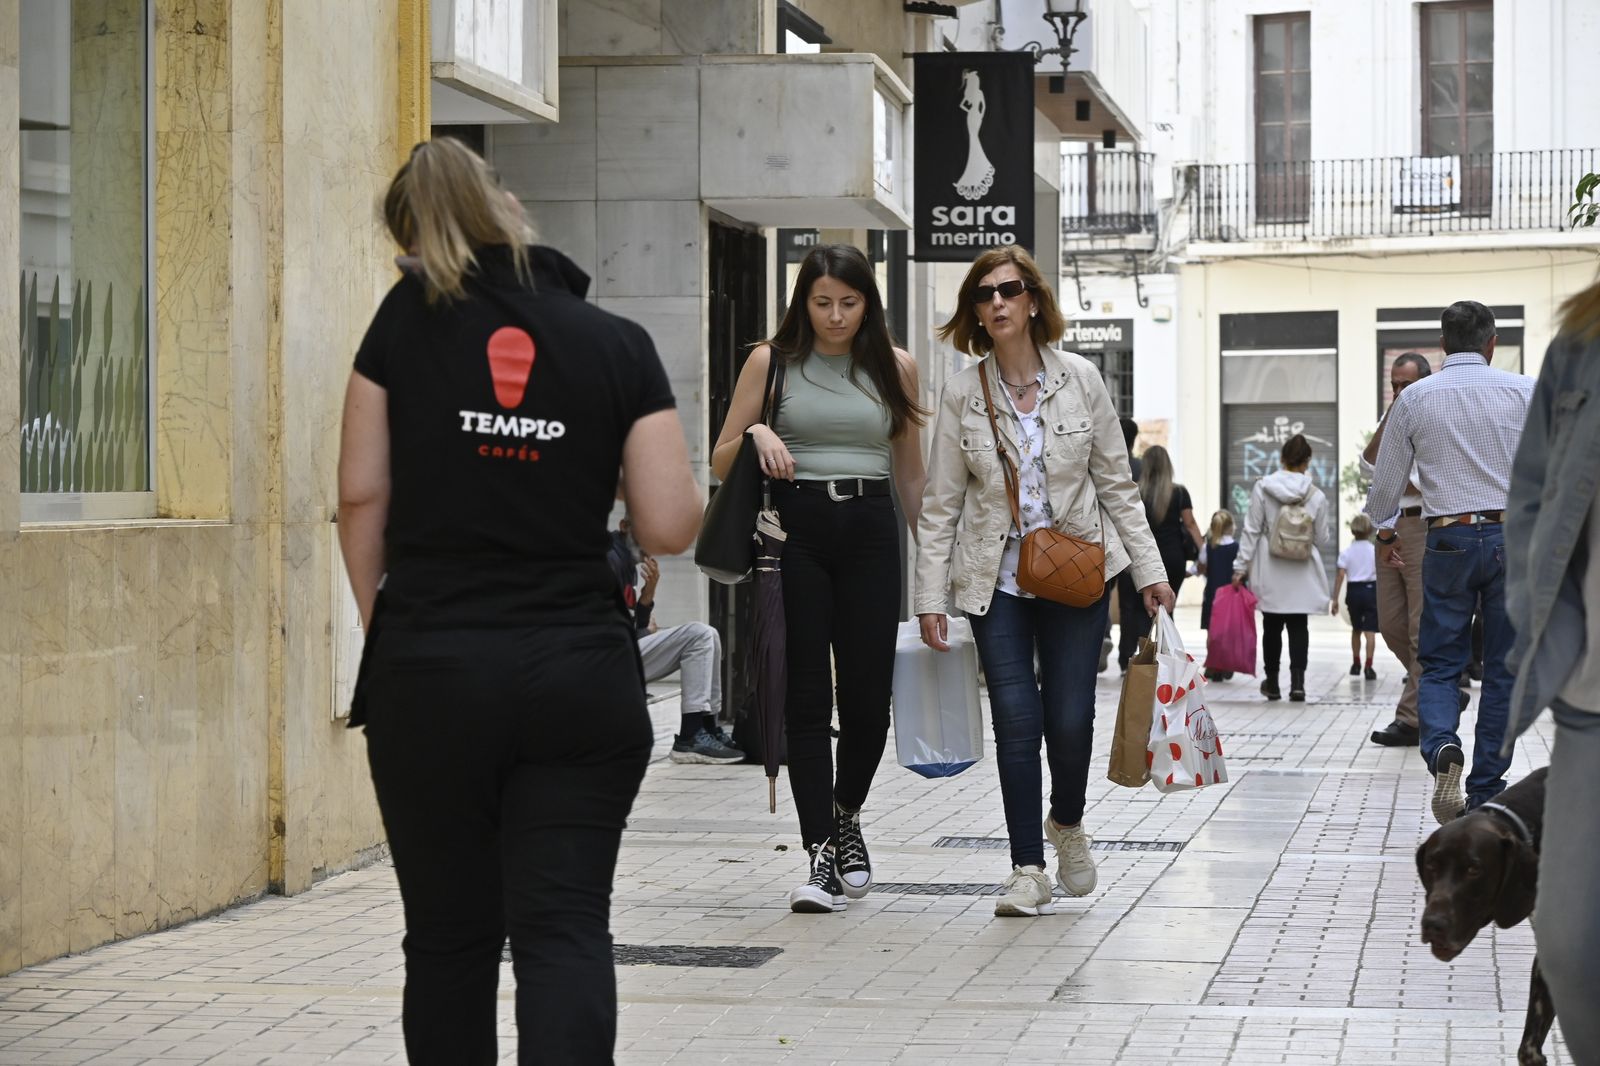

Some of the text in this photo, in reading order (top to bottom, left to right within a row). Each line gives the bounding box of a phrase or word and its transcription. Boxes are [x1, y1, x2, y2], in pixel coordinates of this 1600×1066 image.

[931, 205, 1016, 226] sara
[931, 227, 1016, 246] merino
[458, 410, 566, 440] TEMPLO
